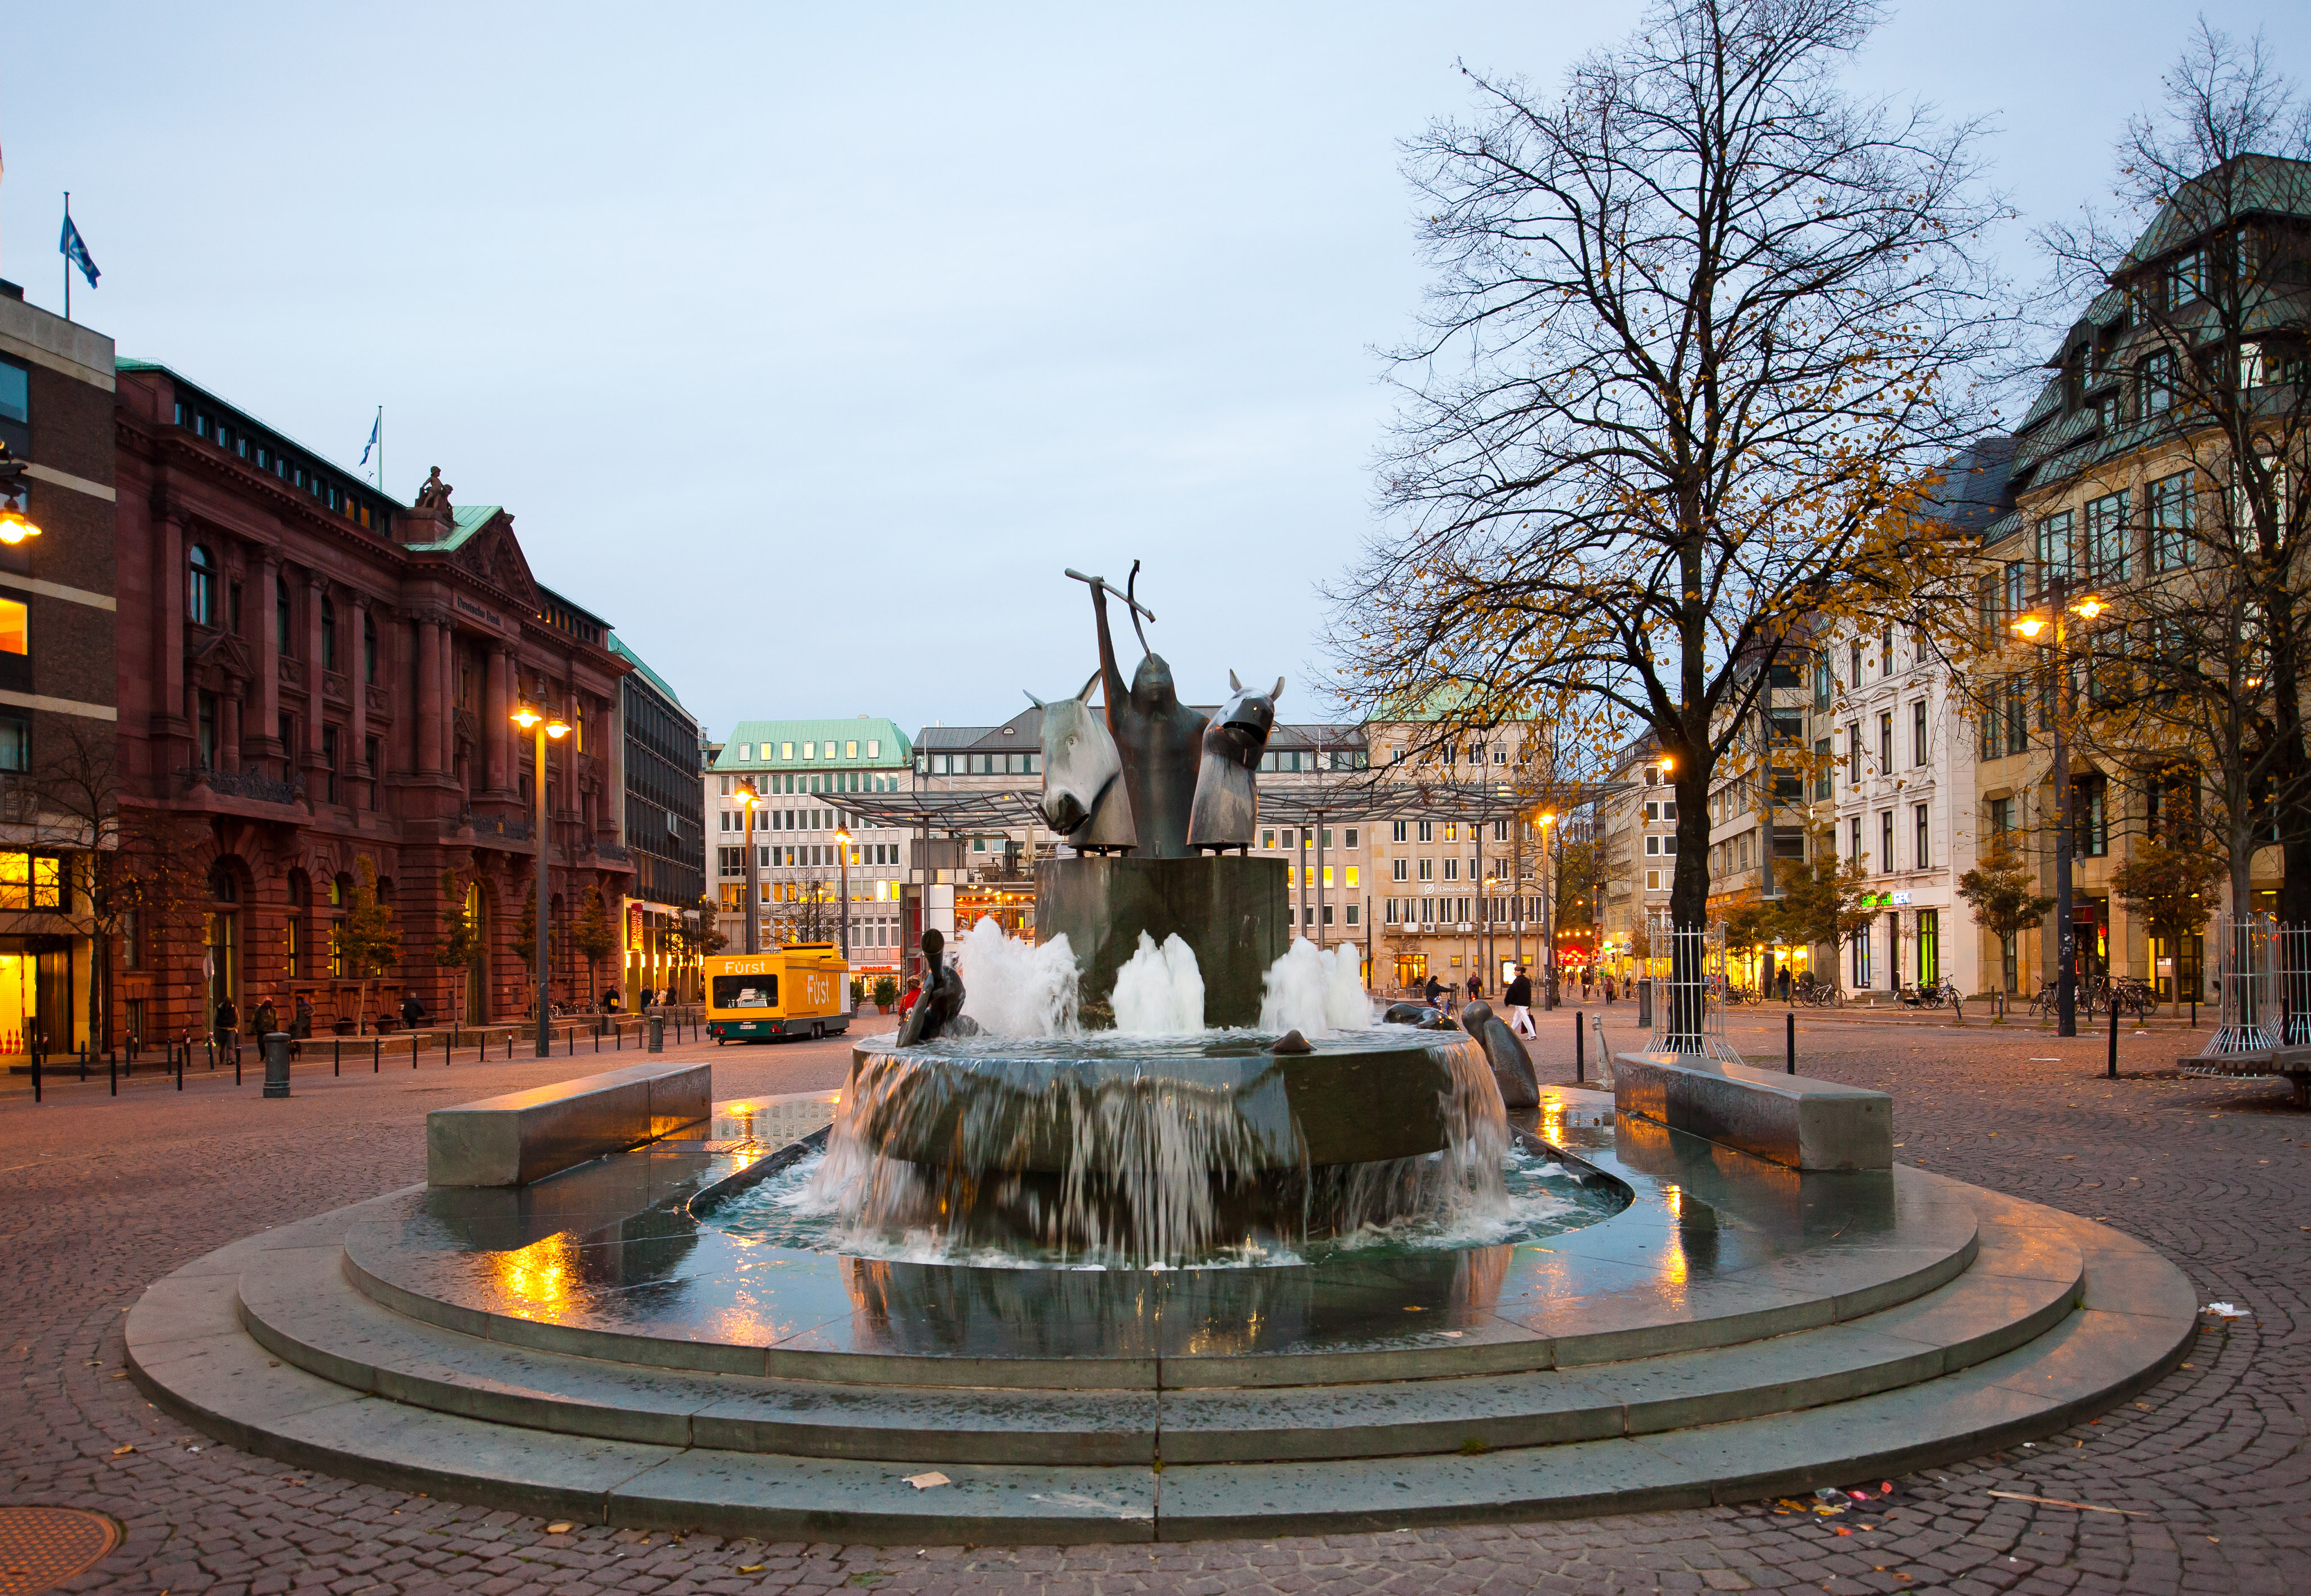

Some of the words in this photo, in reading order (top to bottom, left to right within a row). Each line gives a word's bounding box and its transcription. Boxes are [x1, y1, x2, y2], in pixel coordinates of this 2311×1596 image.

[457, 596, 485, 618] Deutsche
[486, 610, 501, 627] Bank
[1893, 892, 1910, 905] GEK
[724, 961, 765, 974] Fürst
